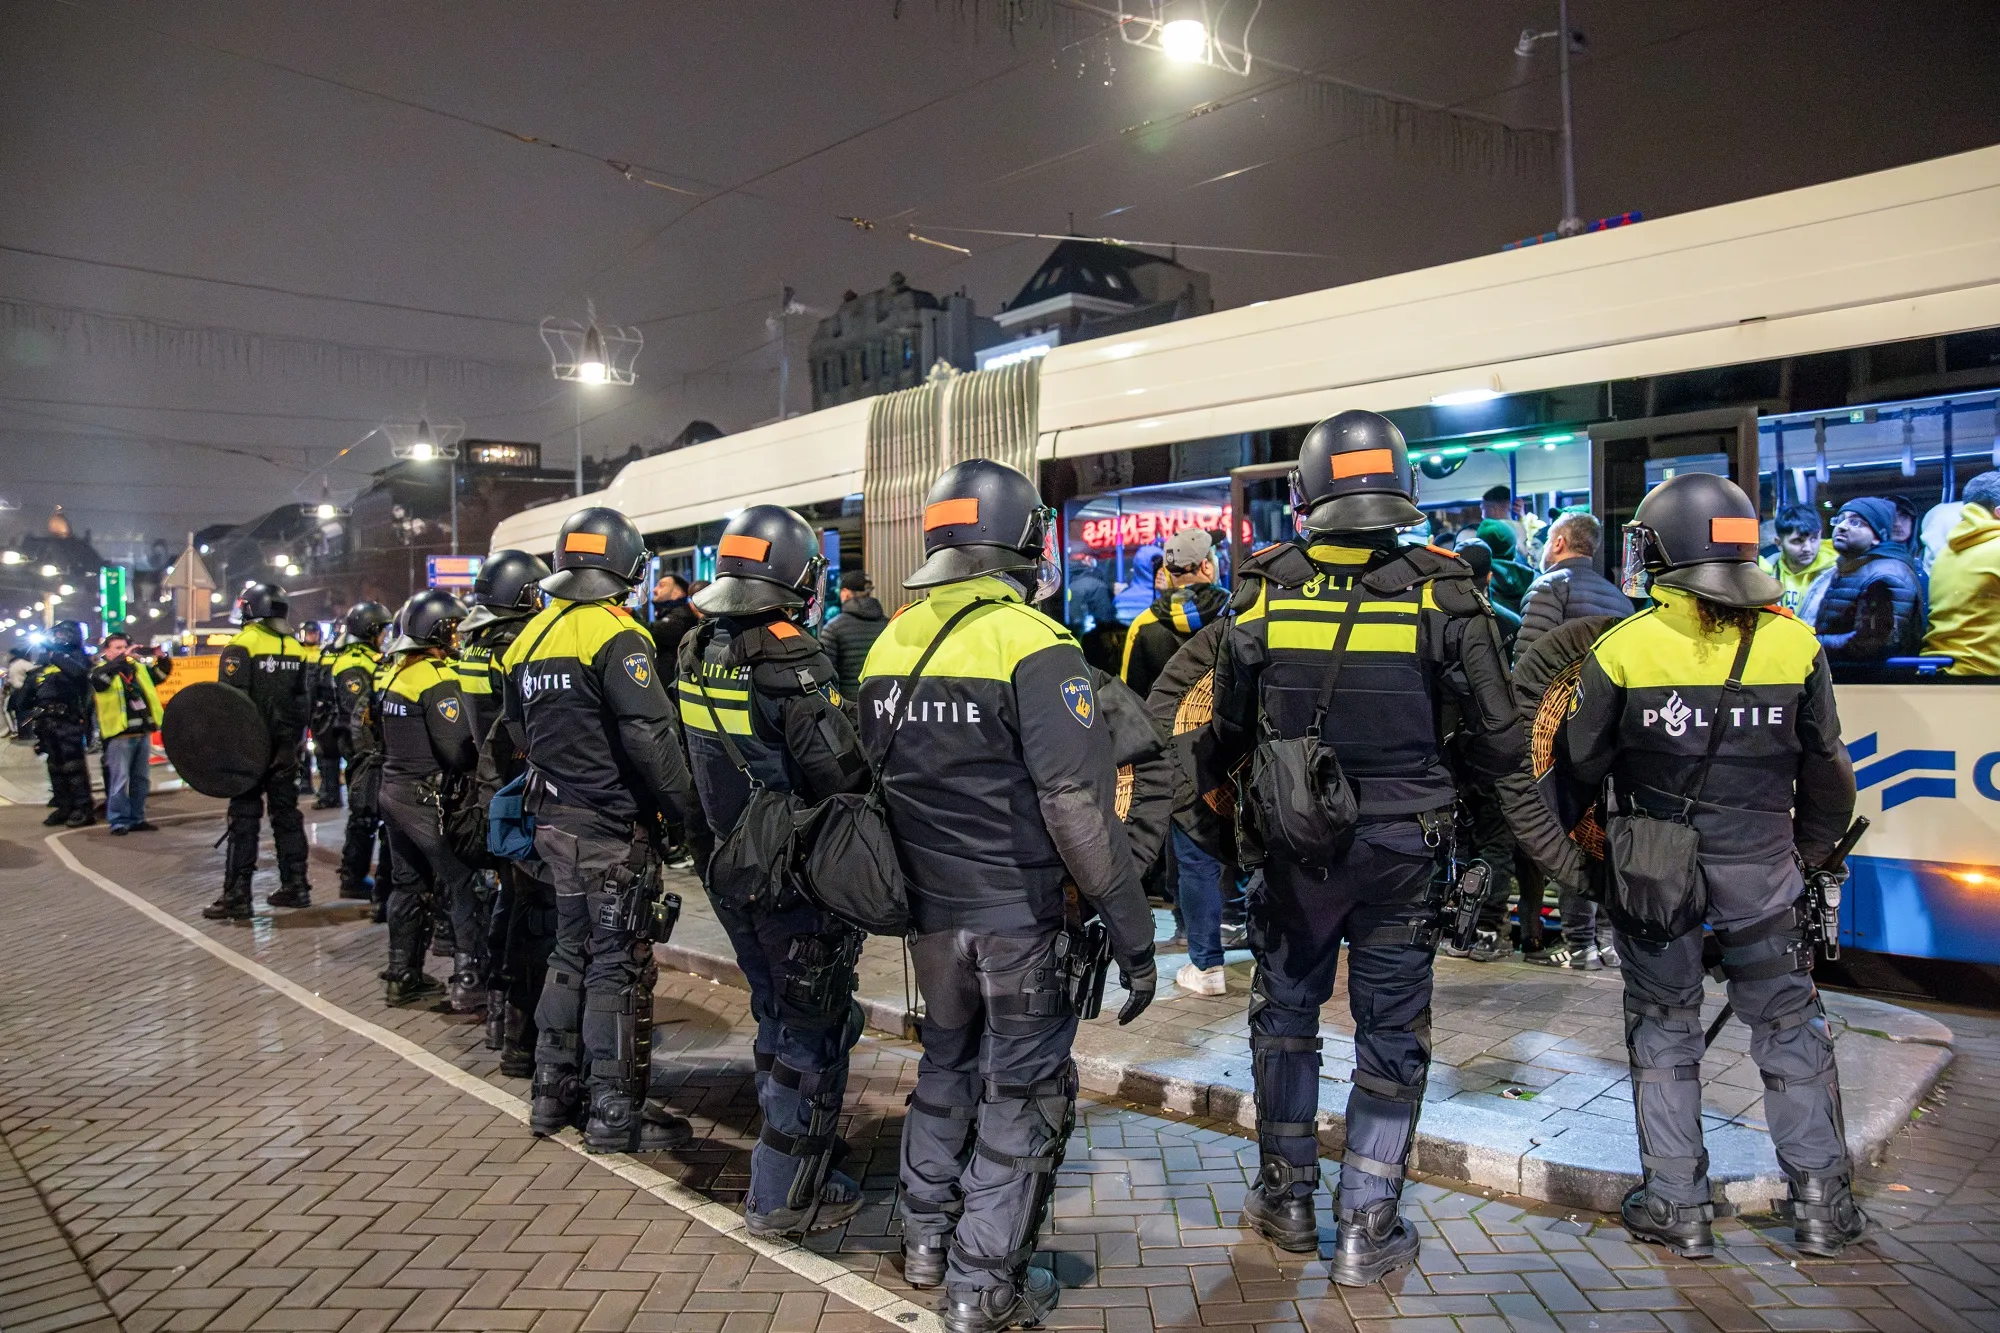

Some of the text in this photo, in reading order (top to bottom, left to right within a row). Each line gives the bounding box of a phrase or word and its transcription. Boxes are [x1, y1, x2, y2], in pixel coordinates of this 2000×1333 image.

[691, 660, 741, 683] LITIE
[383, 701, 407, 717] LITIE
[1643, 699, 1783, 737] POLTIE
